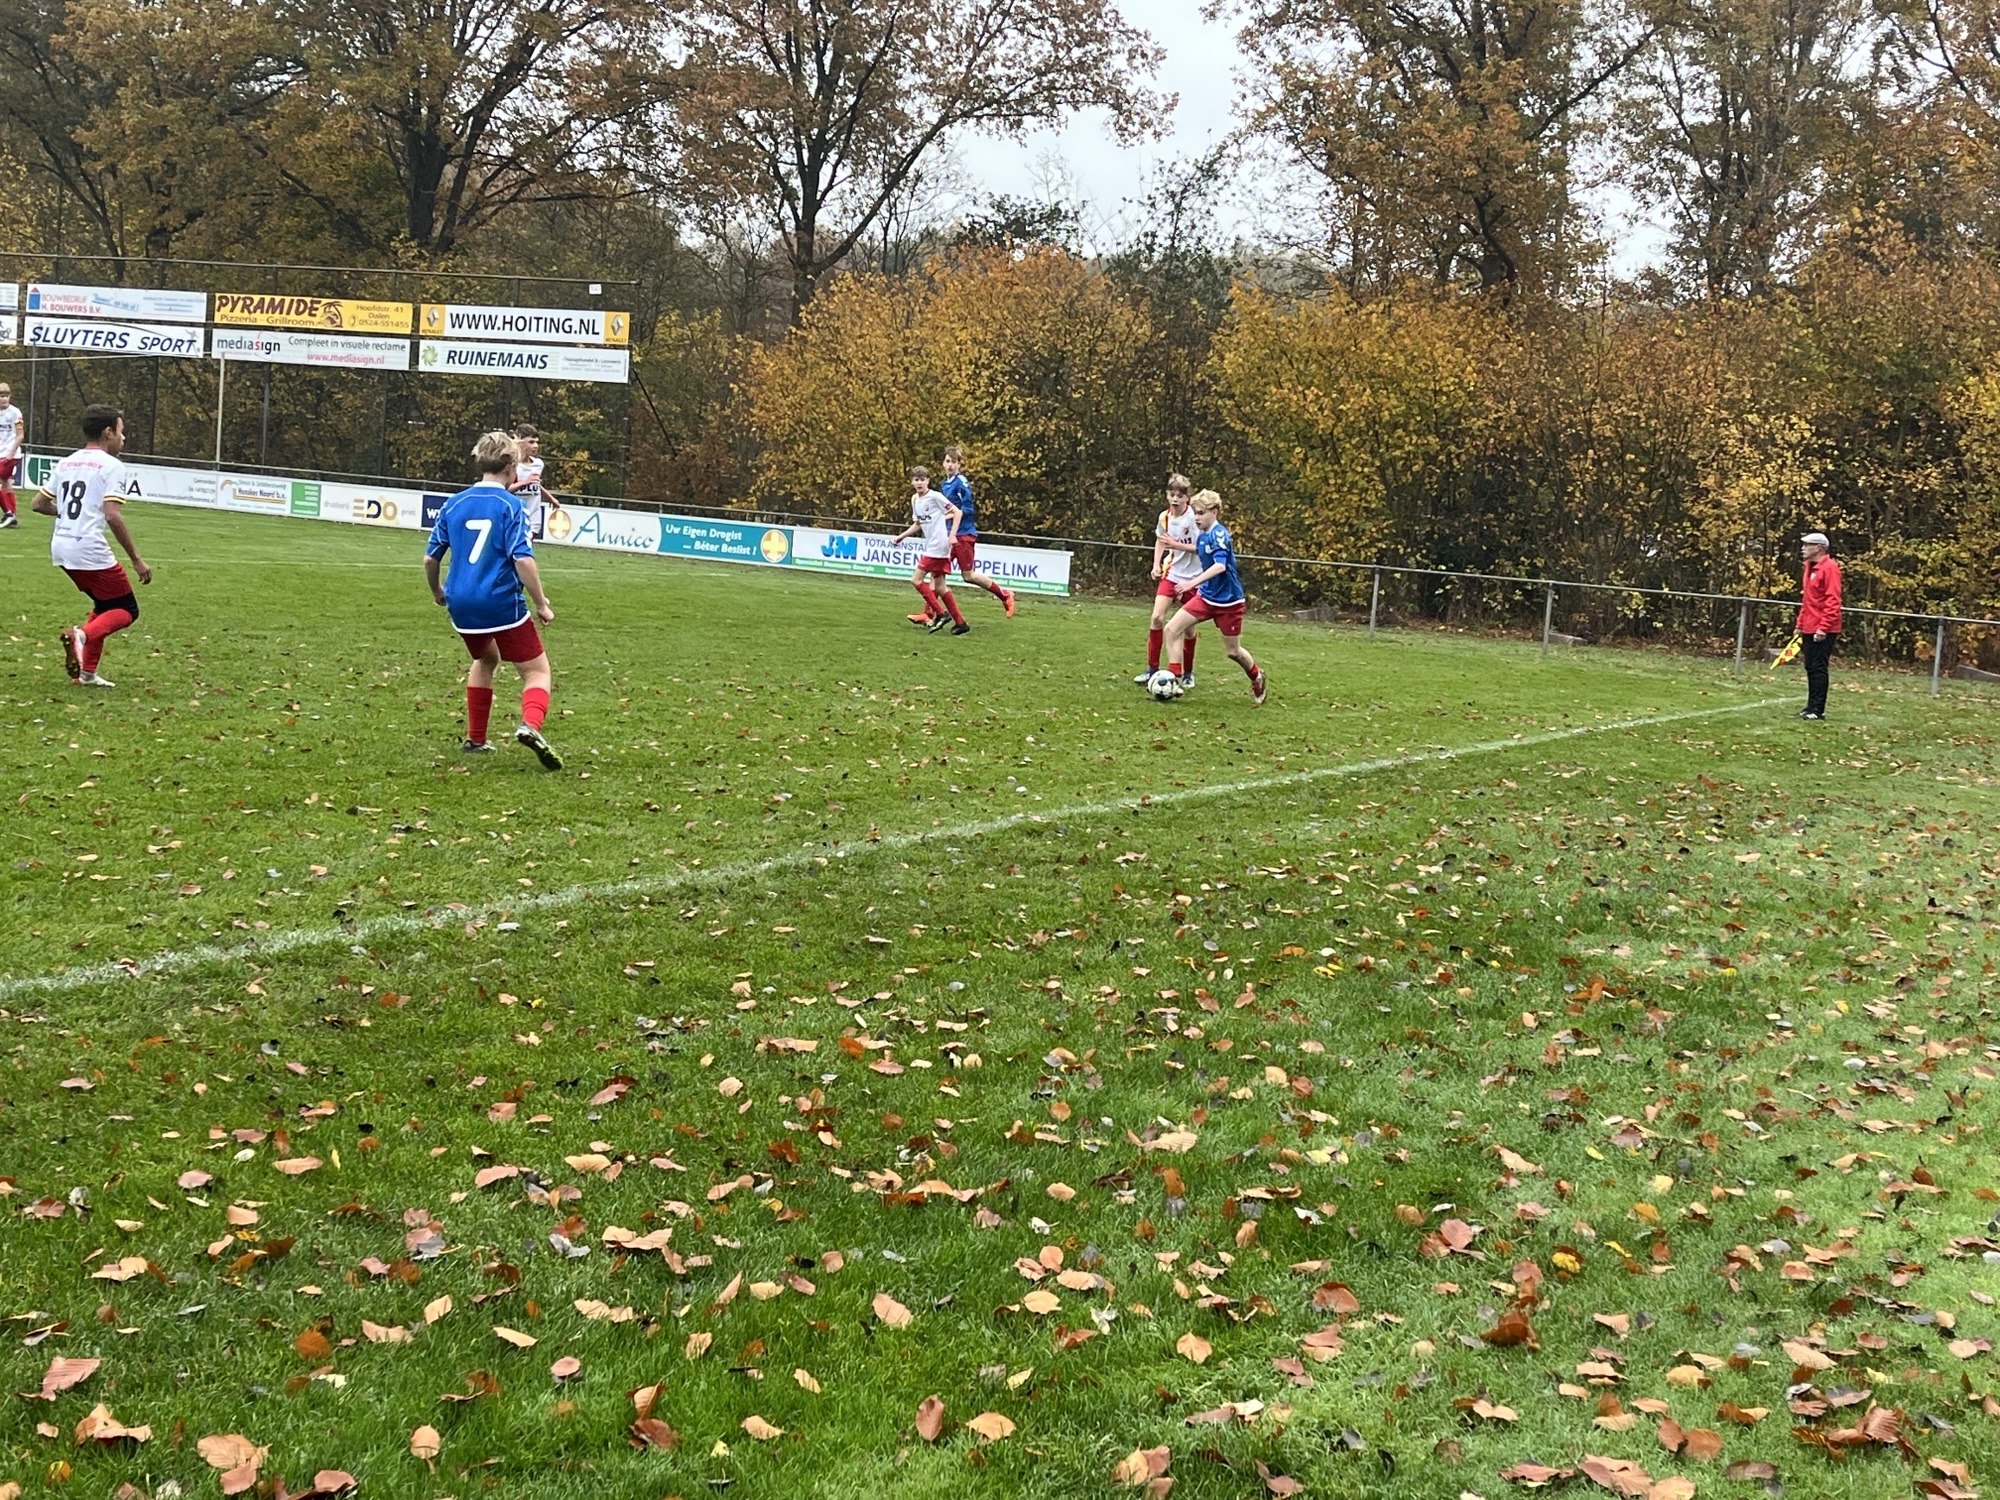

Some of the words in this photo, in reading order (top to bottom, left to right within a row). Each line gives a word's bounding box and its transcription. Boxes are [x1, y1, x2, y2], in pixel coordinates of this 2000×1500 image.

[49, 304, 88, 314] BOUWERS
[216, 295, 322, 318] PYRAMIDE
[368, 312, 390, 320] Dalen
[220, 313, 258, 324] Pizzeria
[266, 315, 316, 327] Grillroom
[449, 312, 601, 336] WWW.HOITING.NL
[29, 325, 130, 350] SLUYTERS
[137, 336, 197, 354] SPORT
[216, 335, 281, 355] mediasign
[287, 335, 329, 348] Compleet
[331, 340, 339, 348] in
[340, 340, 370, 350] visuele
[371, 342, 406, 352] reclame
[306, 352, 385, 367] www.mediasign.nl
[445, 349, 549, 370] RUINEMANS
[62, 480, 87, 521] 18
[572, 511, 655, 548] Annico
[665, 523, 681, 534] Uw
[682, 525, 707, 539] Eigen
[708, 528, 742, 542] Drogist
[465, 519, 493, 565] 7
[693, 540, 719, 553] Béter
[720, 544, 750, 556] Beslist
